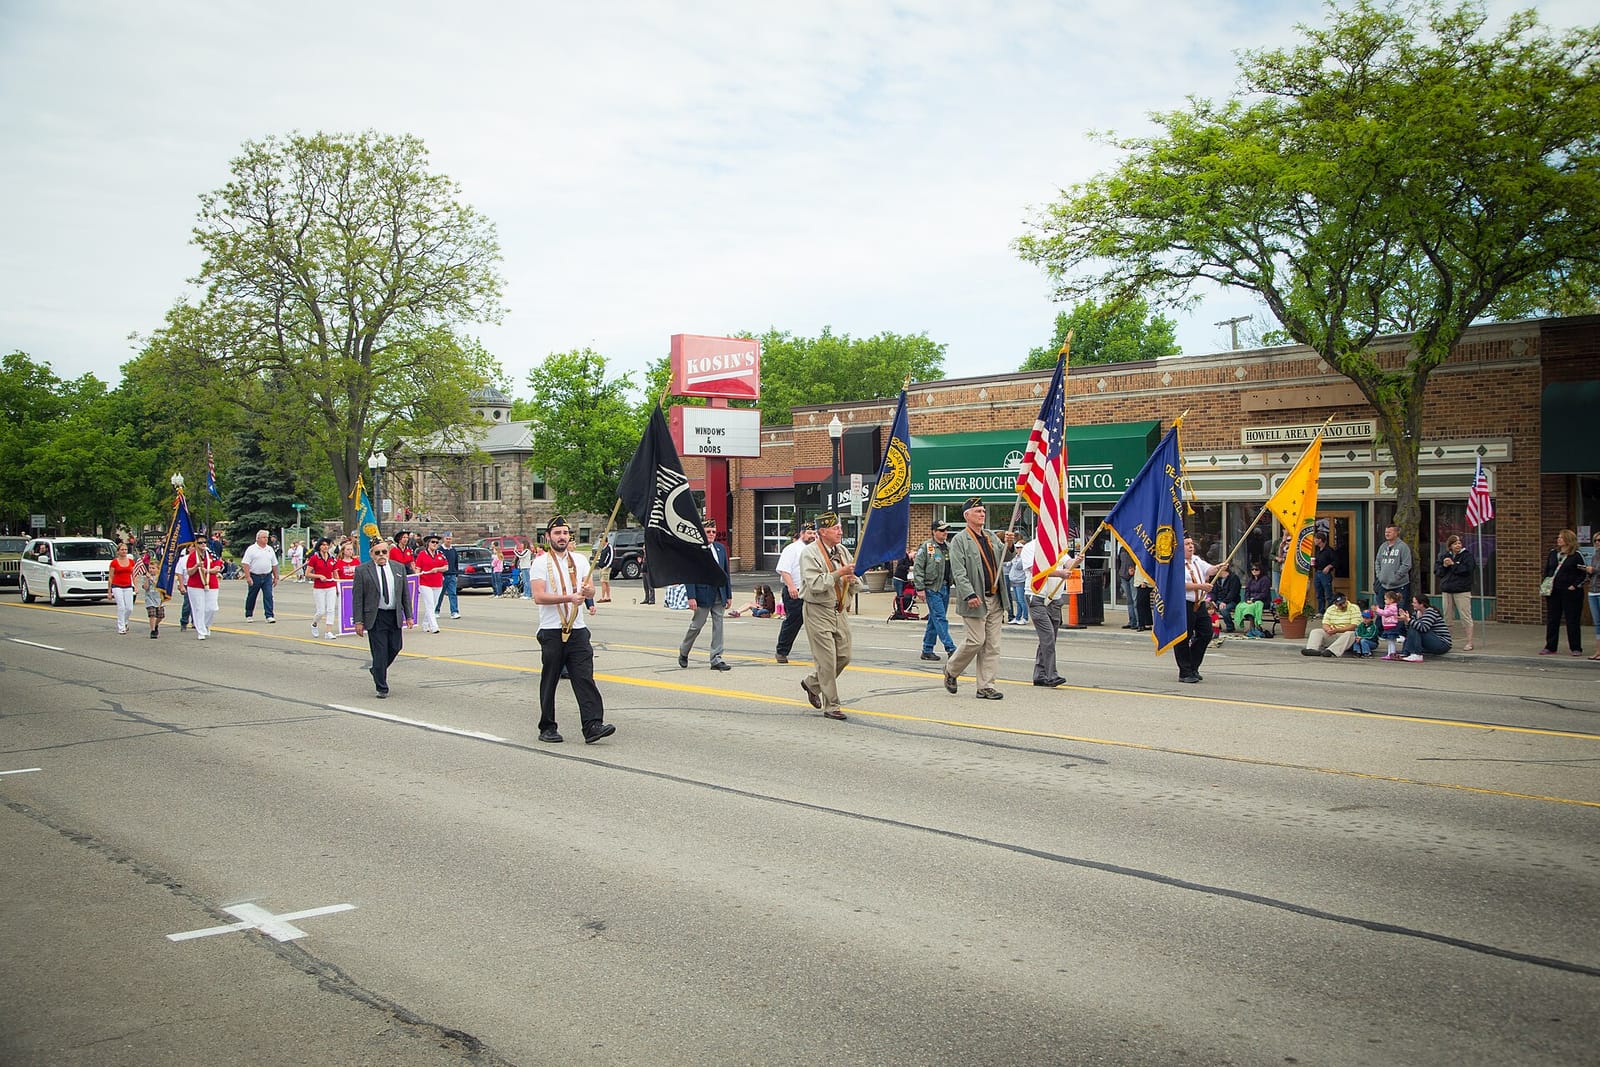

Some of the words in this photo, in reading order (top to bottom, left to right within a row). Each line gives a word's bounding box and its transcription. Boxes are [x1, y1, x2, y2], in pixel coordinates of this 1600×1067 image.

[687, 352, 754, 374] KOSIN'S
[695, 427, 725, 436] WINDOWS
[1246, 430, 1281, 441] HOWELL
[1284, 429, 1308, 439] AREA
[1346, 424, 1371, 435] CLUB
[699, 445, 721, 454] DOORS
[1093, 473, 1116, 488] CO.
